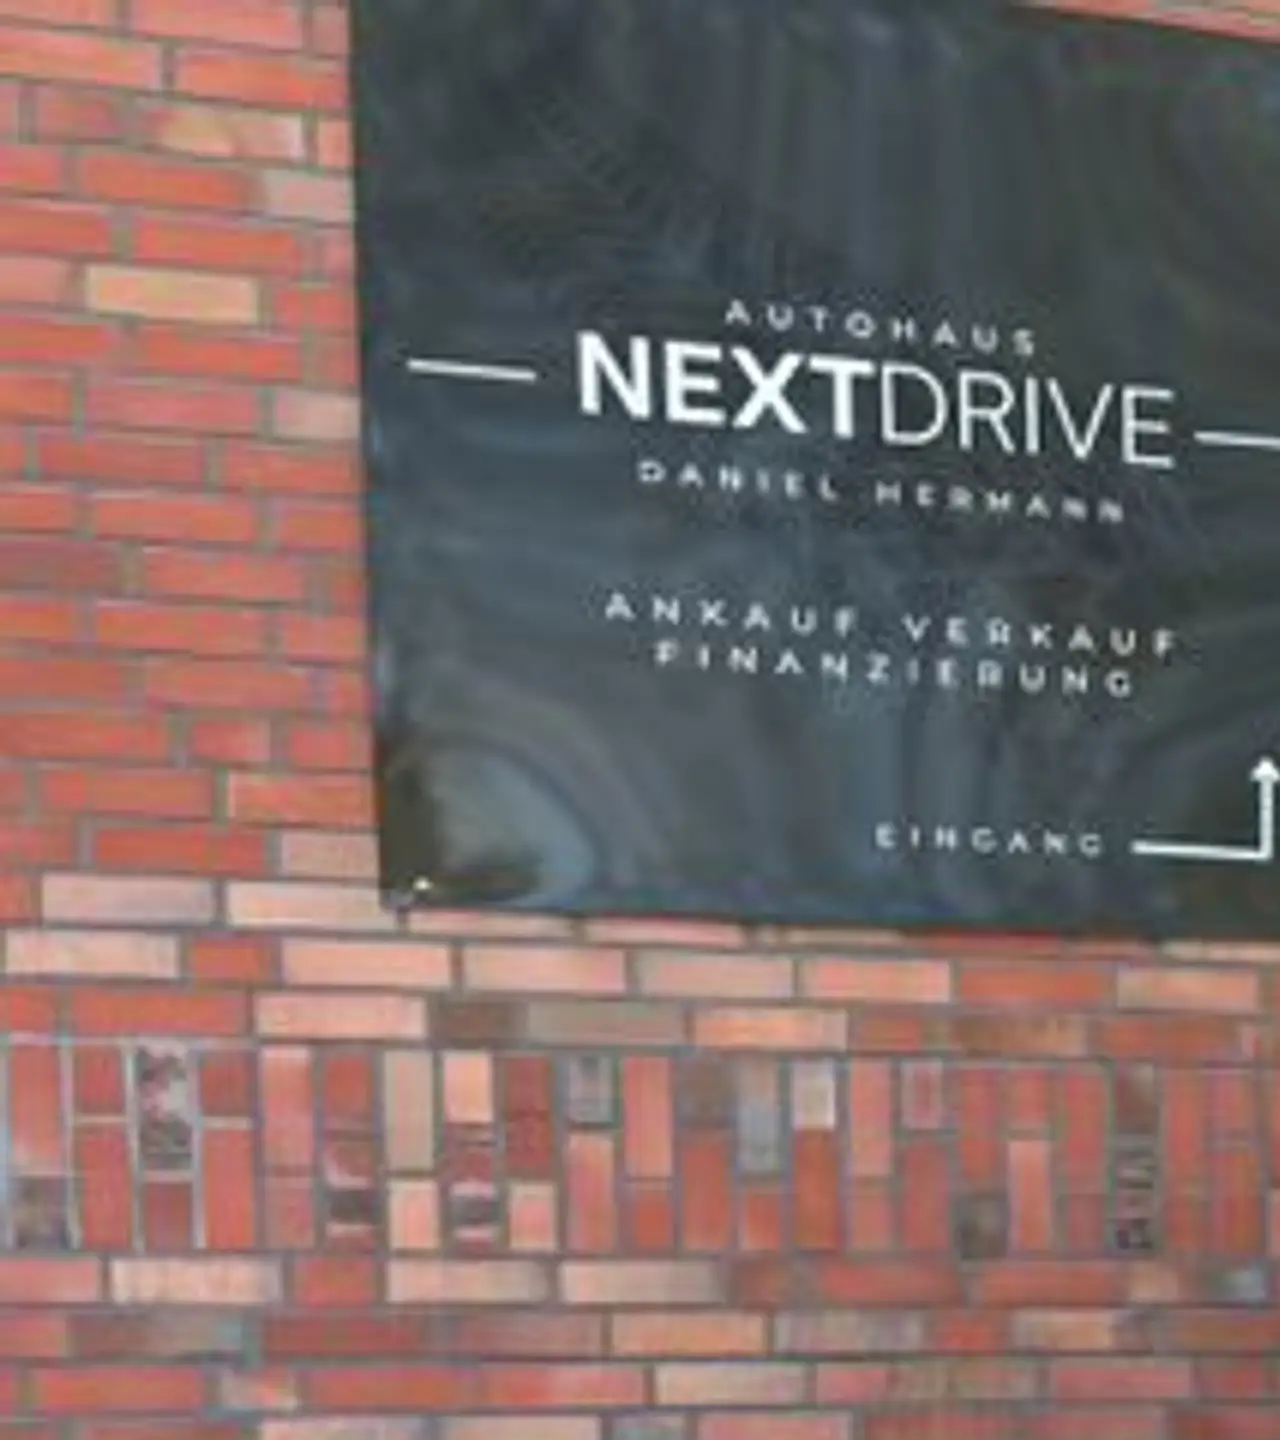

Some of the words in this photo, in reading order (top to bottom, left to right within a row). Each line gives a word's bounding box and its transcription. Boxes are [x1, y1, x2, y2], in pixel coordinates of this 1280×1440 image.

[724, 298, 1036, 358] AUTOHAUS
[637, 457, 838, 503] DANIEL
[874, 480, 1125, 524] HERMANN
[604, 591, 856, 638] ANKAUF
[900, 613, 1174, 658] VERKAUF
[654, 637, 1132, 699] FINANZIERUNG
[873, 821, 1103, 859] EINGANG
